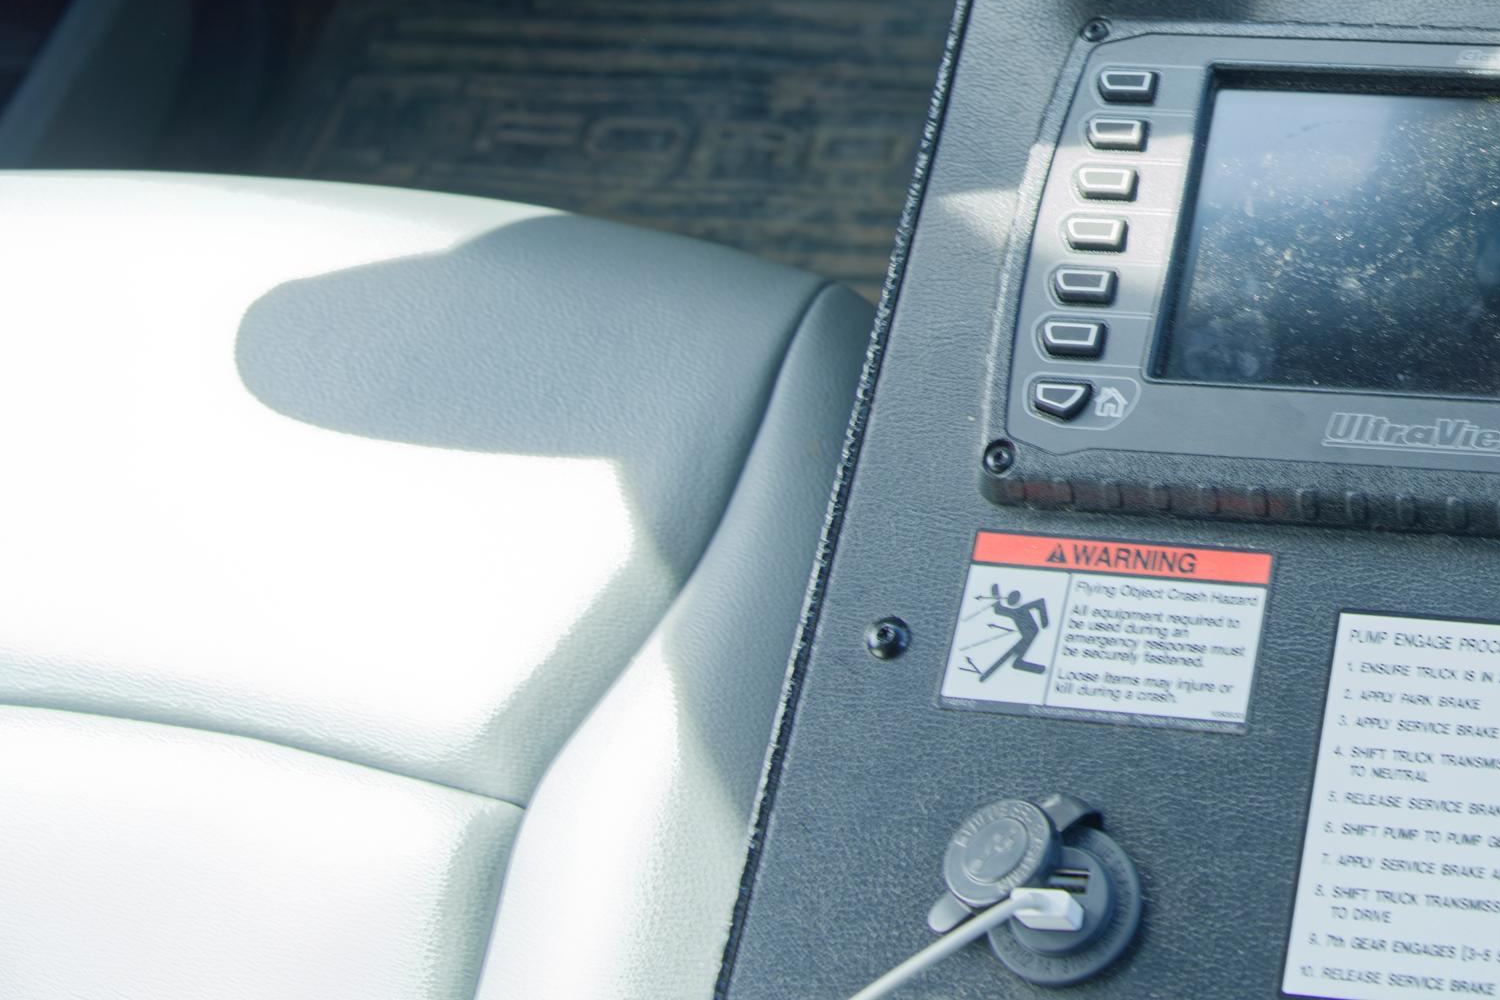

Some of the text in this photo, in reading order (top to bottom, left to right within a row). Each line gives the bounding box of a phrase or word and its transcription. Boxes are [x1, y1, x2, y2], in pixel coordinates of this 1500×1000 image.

[1072, 545, 1197, 575] WARNING
[1075, 581, 1260, 607] Flying Object Crash Hazard
[1067, 617, 1190, 639] be used during an
[1072, 604, 1241, 628] All equipment required to
[1064, 632, 1246, 657] emergency response must
[1349, 628, 1388, 644] PUMP
[1393, 631, 1453, 651] ENGAGE
[1062, 644, 1080, 657] be
[1082, 646, 1139, 664] securely
[1057, 667, 1234, 694] Loose items may injure or
[1360, 661, 1412, 677] ENSURE
[1416, 665, 1457, 681] TRUCK
[1462, 669, 1476, 682] IS
[1481, 671, 1494, 683] IN
[1054, 680, 1177, 704] kill during a crash.
[1359, 689, 1395, 704] APPLY
[1400, 692, 1433, 707] PARK
[1438, 695, 1482, 711] BRAKE
[1355, 716, 1391, 731] APPLY
[1396, 719, 1451, 737] SERVICE
[1455, 723, 1500, 740] BRAKE
[1350, 745, 1388, 761] SHIFT
[1392, 748, 1435, 765] TRUCK
[1349, 764, 1430, 784] TO NEUTRAL
[1343, 791, 1402, 809] RELEASE
[1407, 796, 1463, 815] SERVICE
[1341, 822, 1378, 837] SHIFT
[1382, 826, 1420, 841] PUMP
[1424, 829, 1441, 843] TO
[1446, 831, 1483, 846] PUMP
[1337, 853, 1376, 870] APPLY
[1380, 856, 1436, 876] SERVICE
[1441, 862, 1487, 880] BRAKE
[1331, 885, 1370, 900] SHIFT
[1375, 889, 1419, 906] TRUCK
[1330, 905, 1392, 925] TO DRIVE
[1326, 933, 1346, 949] 7th
[1351, 936, 1388, 951] GEAR
[1392, 939, 1456, 959] ENGAGES
[1321, 966, 1383, 985] RELEASE
[1387, 972, 1445, 991] SERVICE
[1450, 979, 1496, 997] BRAKE
